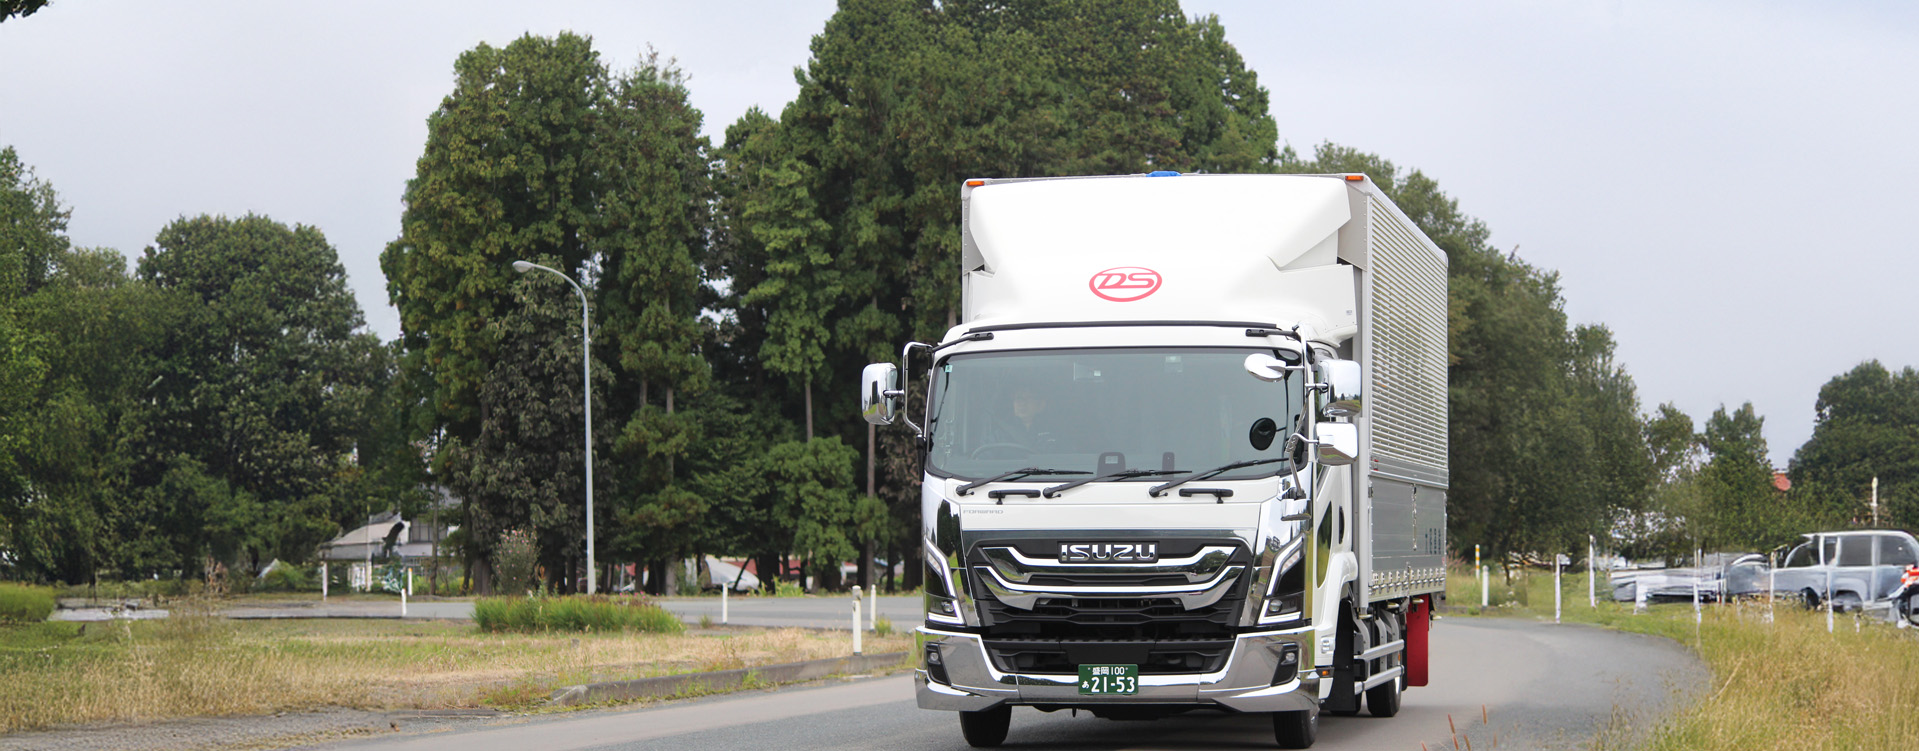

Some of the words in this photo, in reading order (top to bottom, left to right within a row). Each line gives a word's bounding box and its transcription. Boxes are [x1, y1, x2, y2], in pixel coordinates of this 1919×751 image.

[1061, 544, 1156, 561] ISUZU
[1111, 666, 1125, 676] 100
[1091, 676, 1135, 693] 21-53
